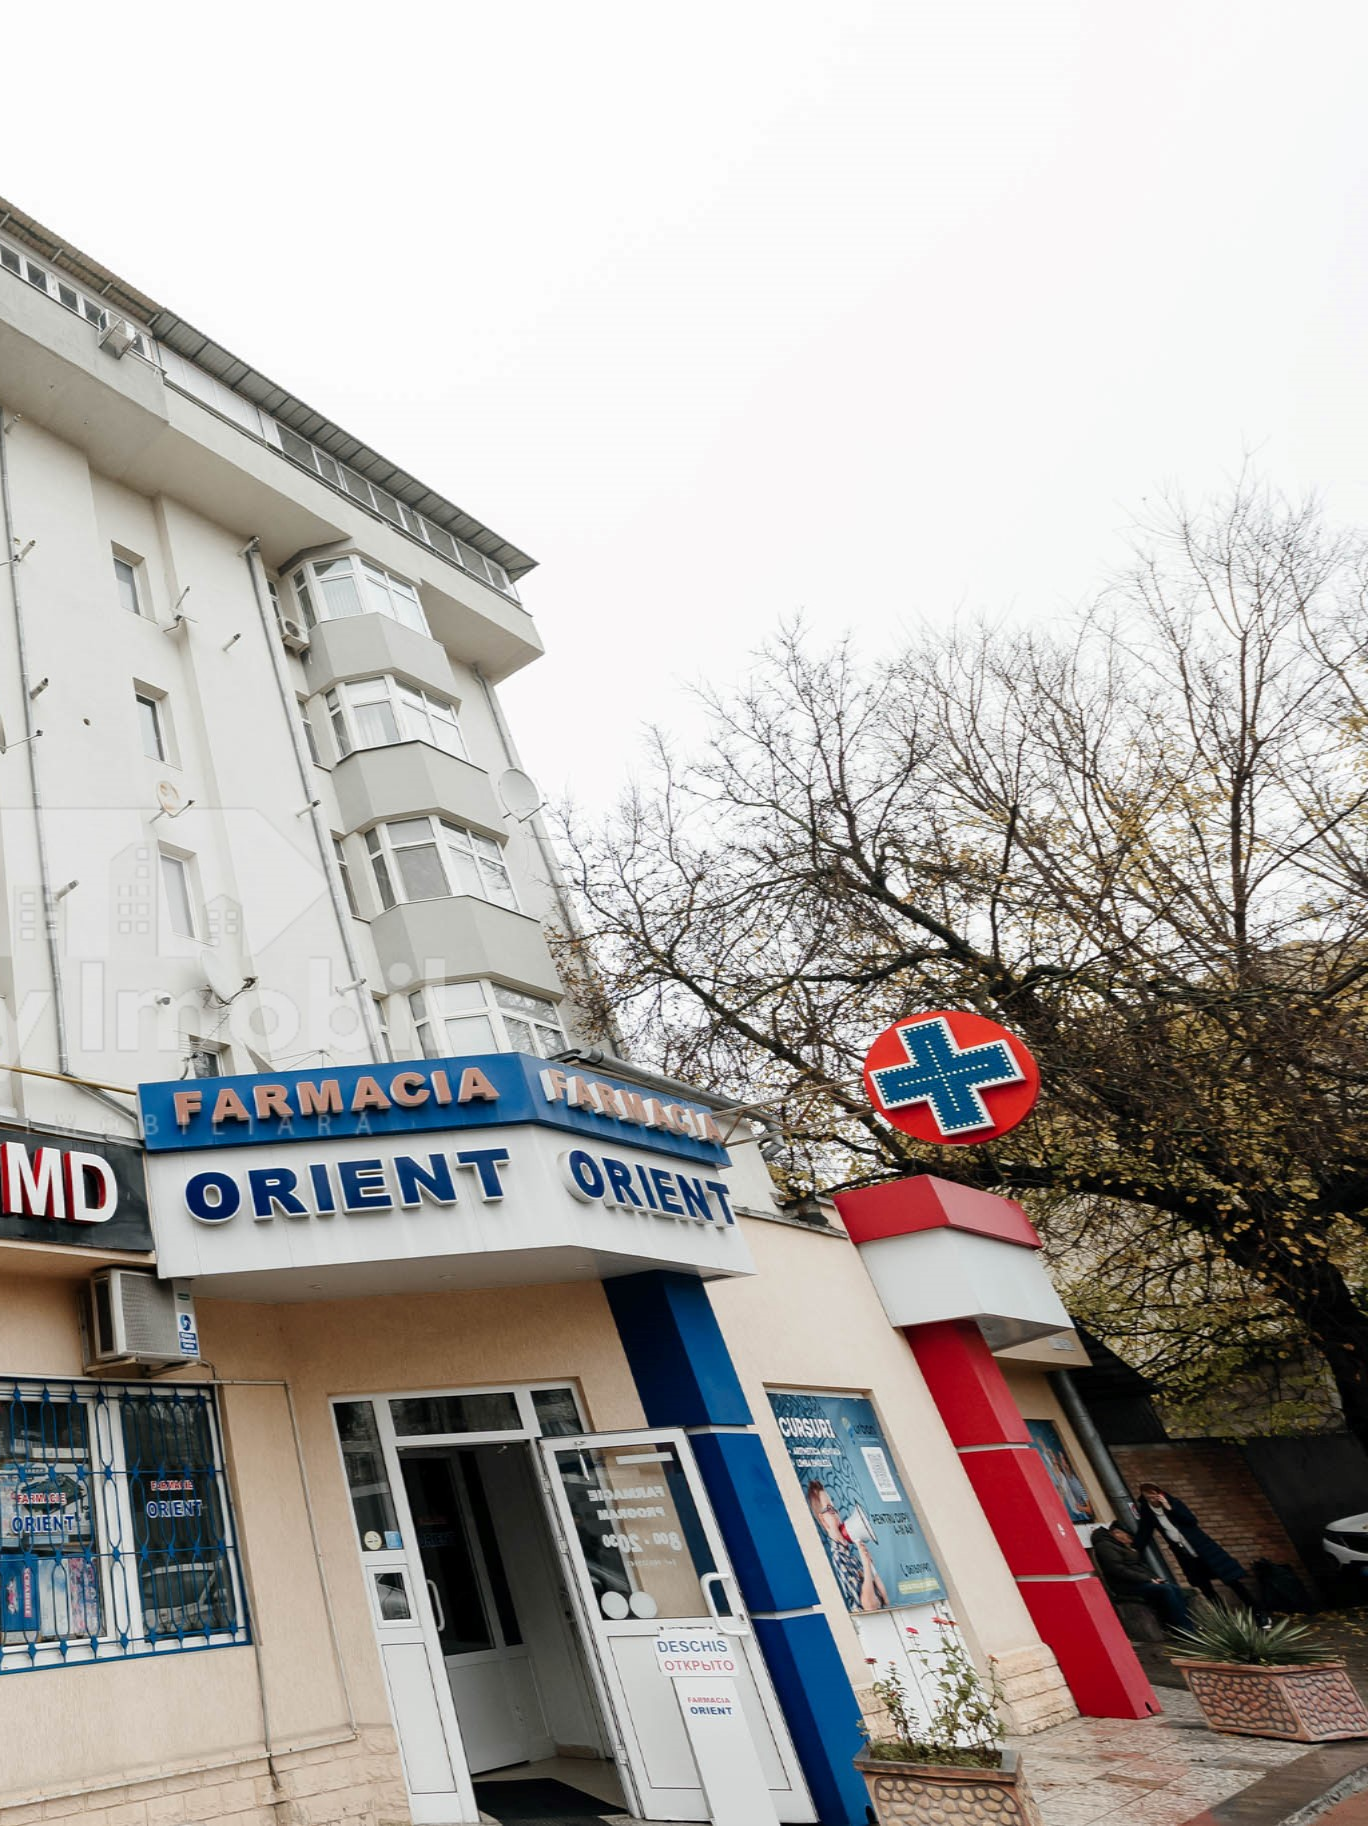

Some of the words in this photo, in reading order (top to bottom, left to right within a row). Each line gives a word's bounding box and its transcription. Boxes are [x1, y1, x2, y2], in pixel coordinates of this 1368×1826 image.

[174, 1067, 500, 1126] FARMACIA
[539, 1068, 725, 1144] FARMACIA
[185, 1147, 512, 1226] ORIENT
[560, 1148, 735, 1230] ORIENT
[779, 1417, 836, 1438] CURSURI
[146, 1500, 202, 1518] ORIENT
[12, 1515, 74, 1534] ORIENT
[656, 1641, 728, 1652] DESCHIS
[664, 1660, 735, 1671] ОТКРЫТО
[690, 1706, 732, 1715] ORIENT
